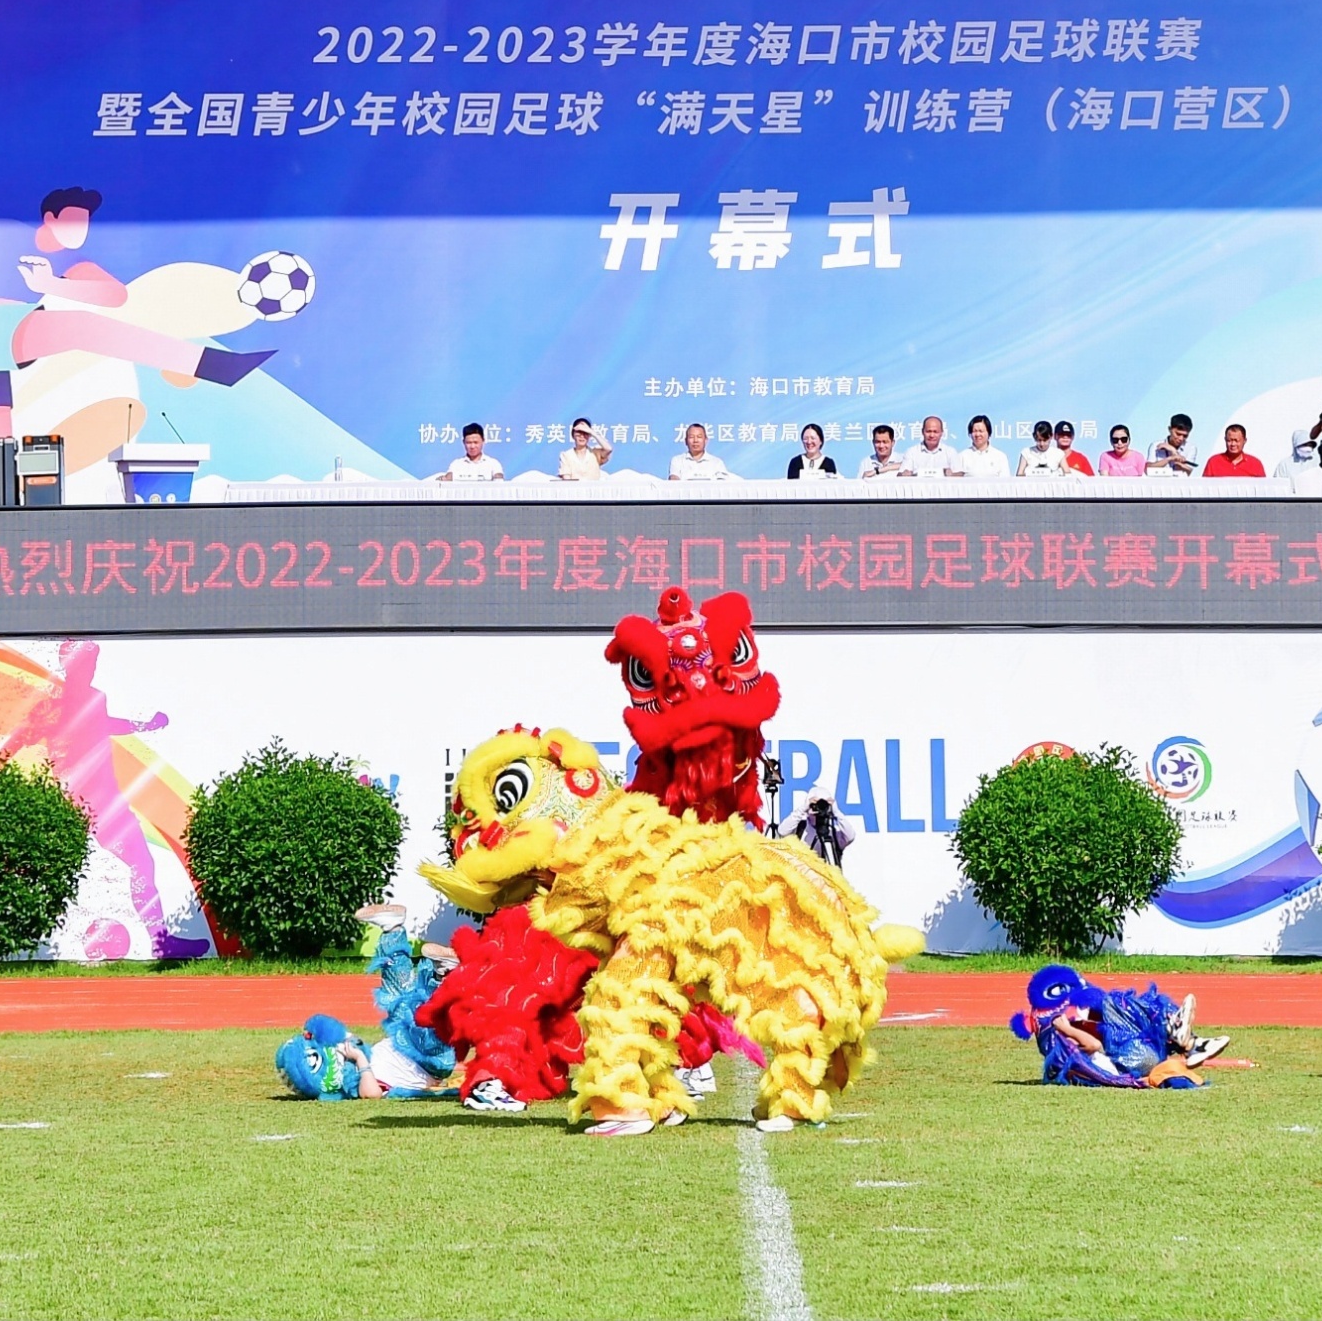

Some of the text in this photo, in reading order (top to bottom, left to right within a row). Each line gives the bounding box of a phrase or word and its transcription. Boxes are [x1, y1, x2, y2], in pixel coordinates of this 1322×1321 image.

[312, 17, 1203, 67] 2022-2023学年度海口市校园足球联赛
[598, 186, 910, 272] 开幕式
